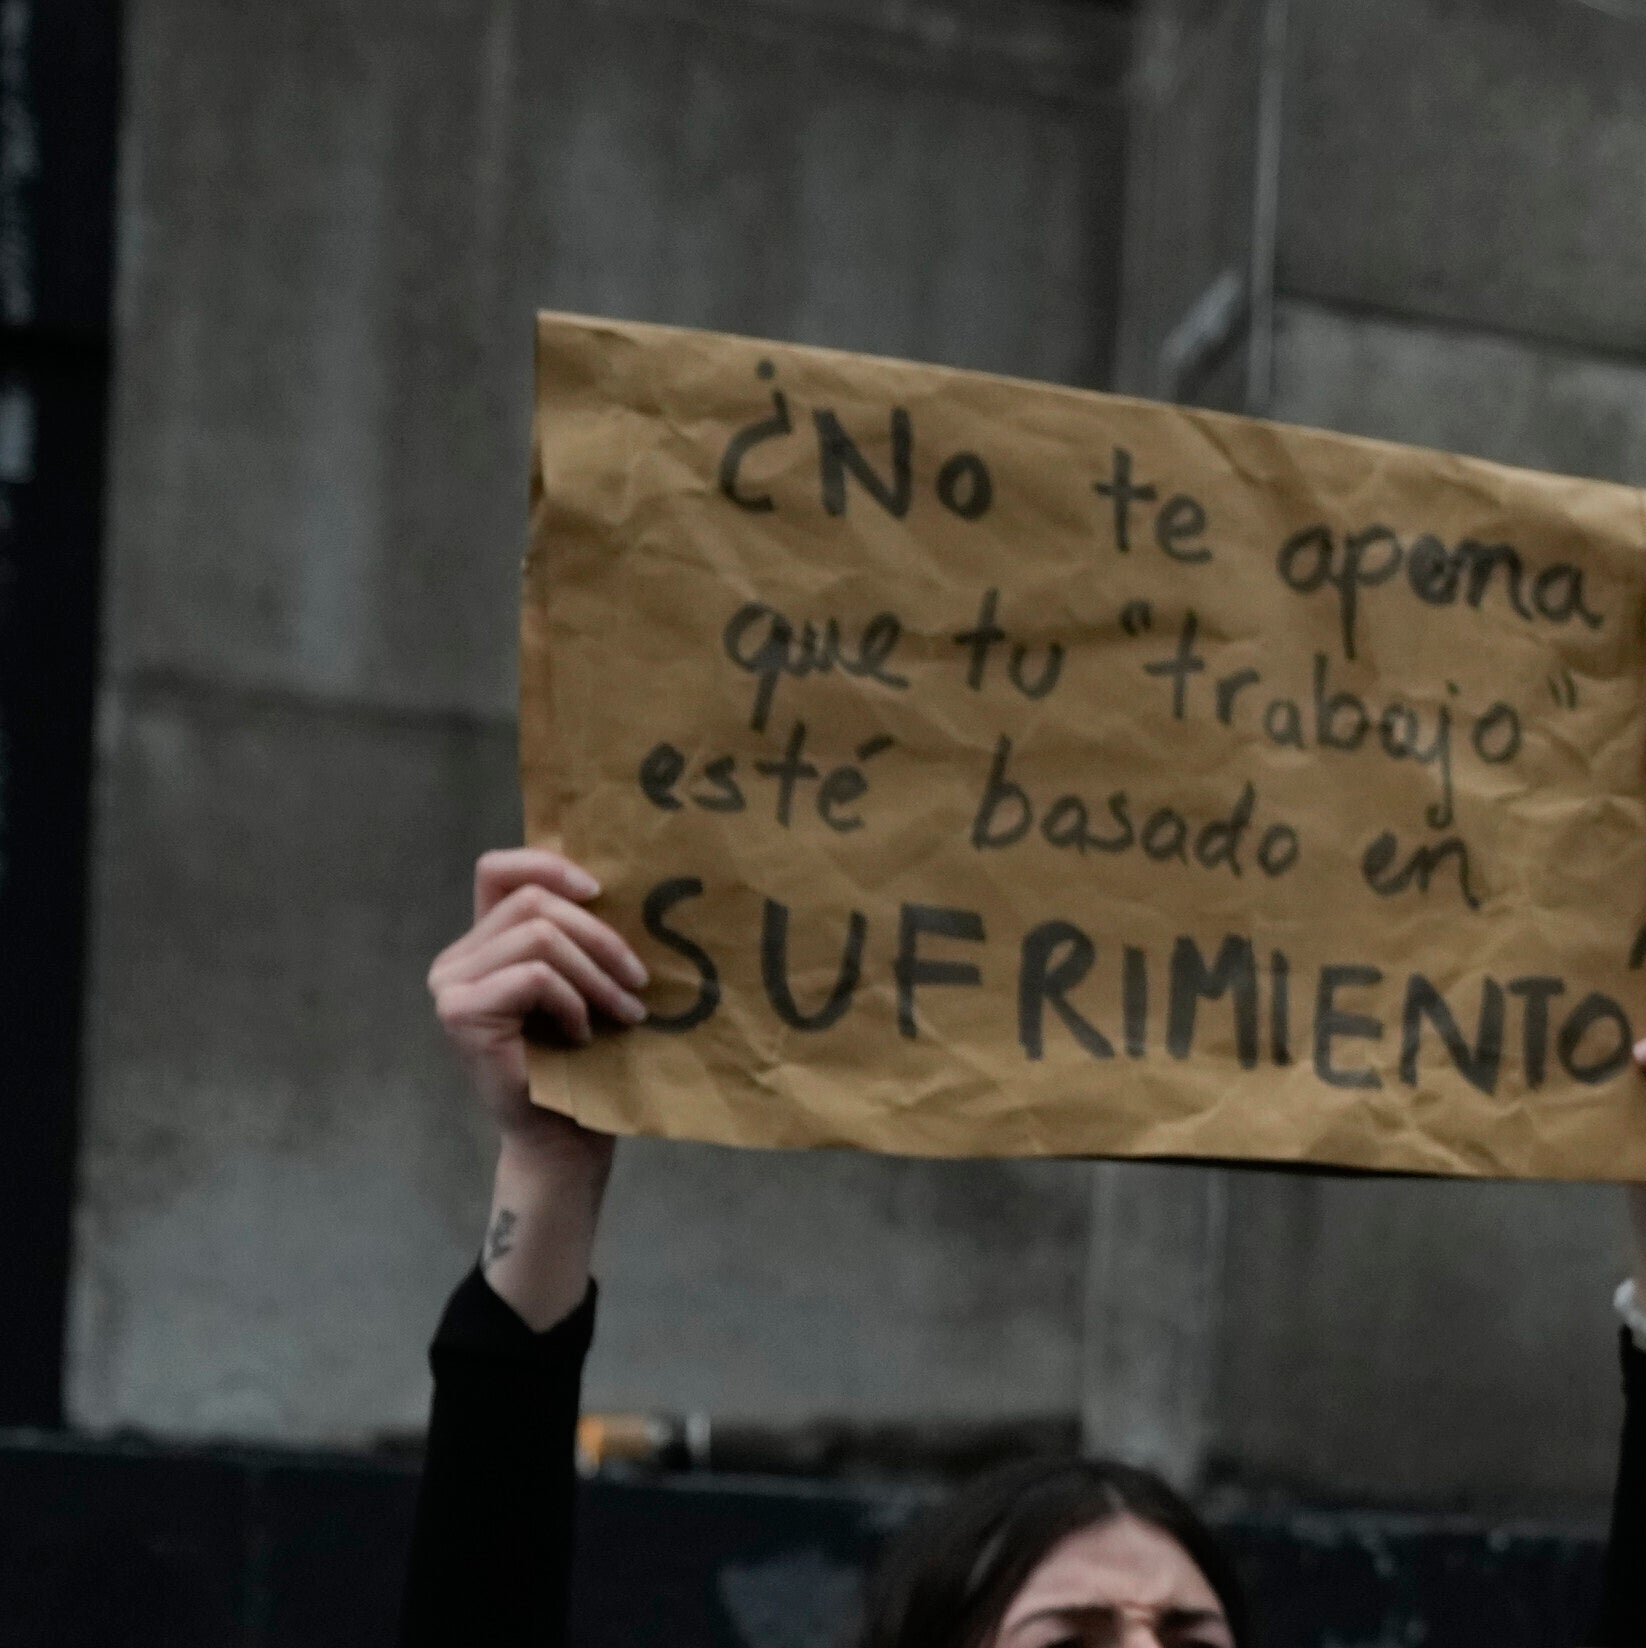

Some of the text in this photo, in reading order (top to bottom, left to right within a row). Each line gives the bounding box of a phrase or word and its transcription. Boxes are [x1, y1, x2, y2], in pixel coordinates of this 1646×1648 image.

[719, 359, 993, 522] ¿No
[1093, 447, 1213, 563] te
[723, 602, 910, 734] que
[954, 588, 1066, 700] tu
[638, 720, 1482, 910] esté basado en
